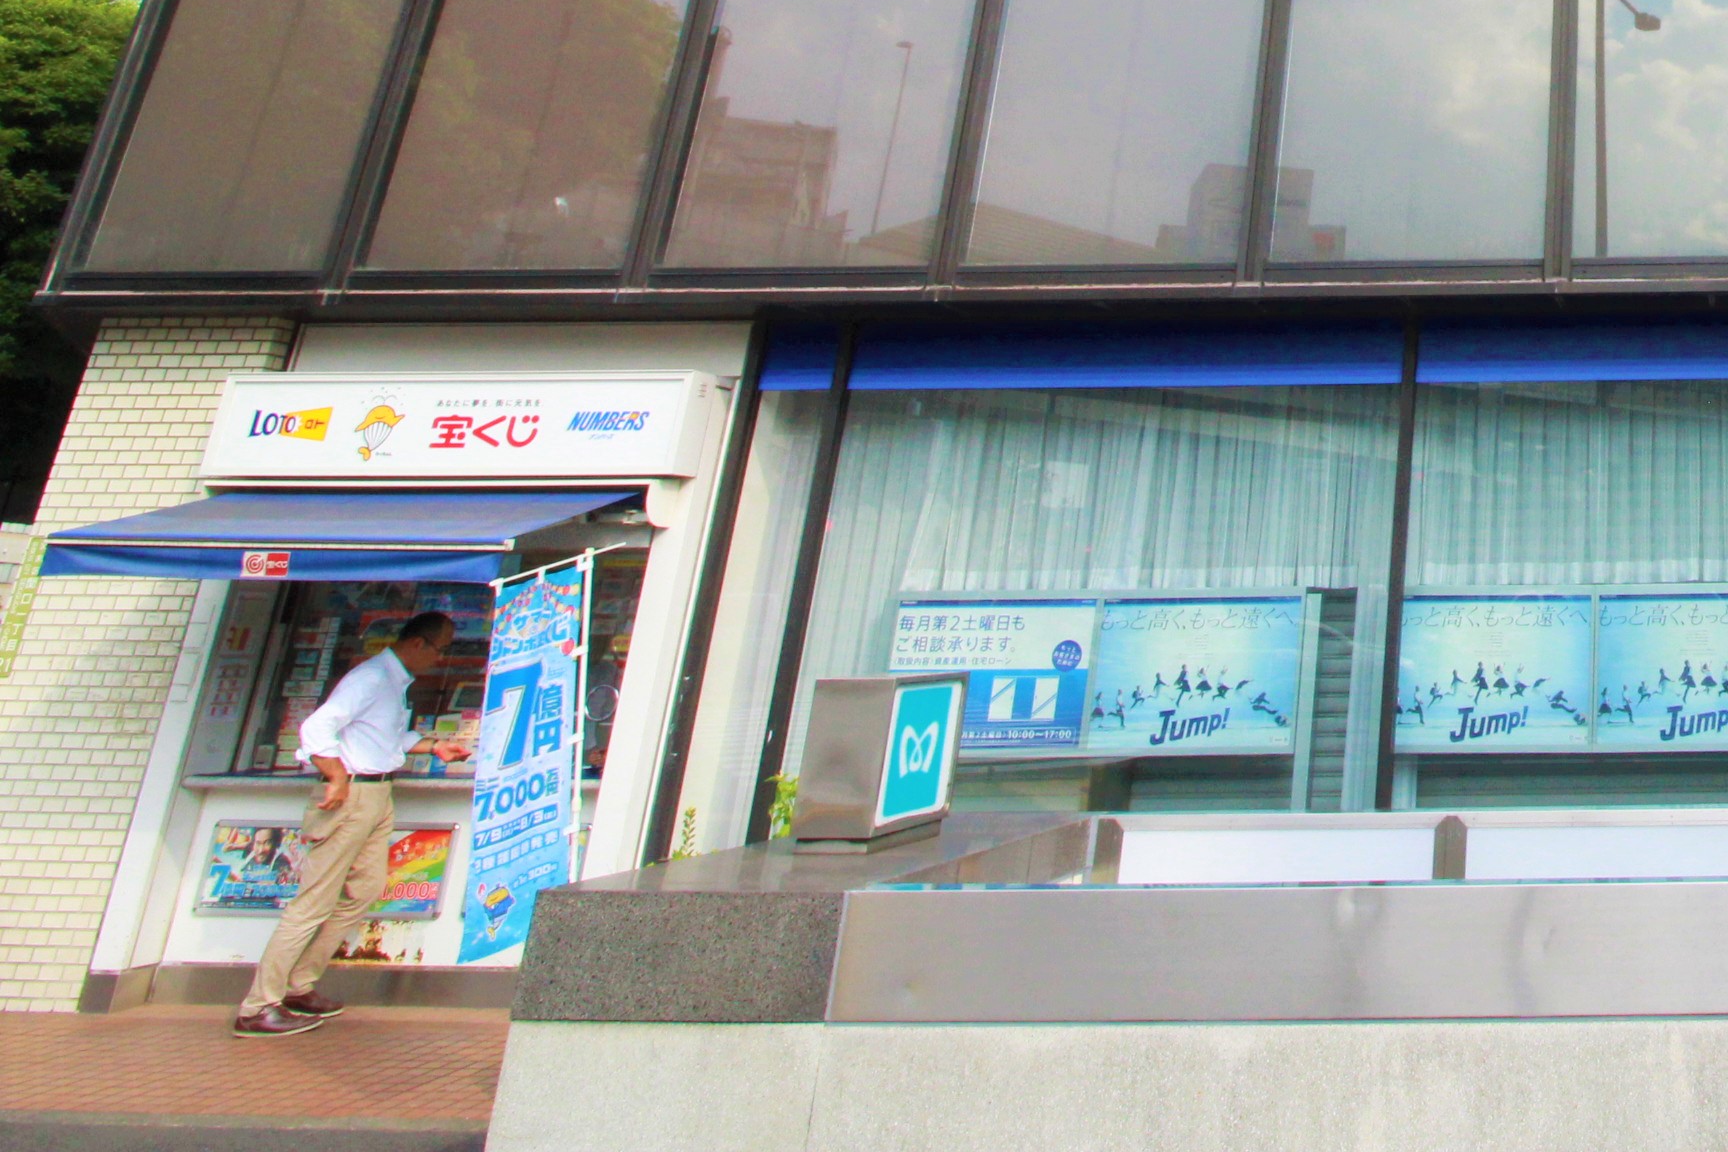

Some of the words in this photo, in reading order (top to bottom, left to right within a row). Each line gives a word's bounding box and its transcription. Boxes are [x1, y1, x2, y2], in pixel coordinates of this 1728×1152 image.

[249, 409, 296, 437] LOTO
[429, 414, 540, 449] 宝くじ
[567, 411, 650, 432] NUMBERS
[899, 615, 1025, 632] 毎月第2土曜日も
[896, 635, 1016, 653] ご相談承ります。
[1150, 708, 1231, 745] Jump!
[1450, 706, 1529, 742] Jump!
